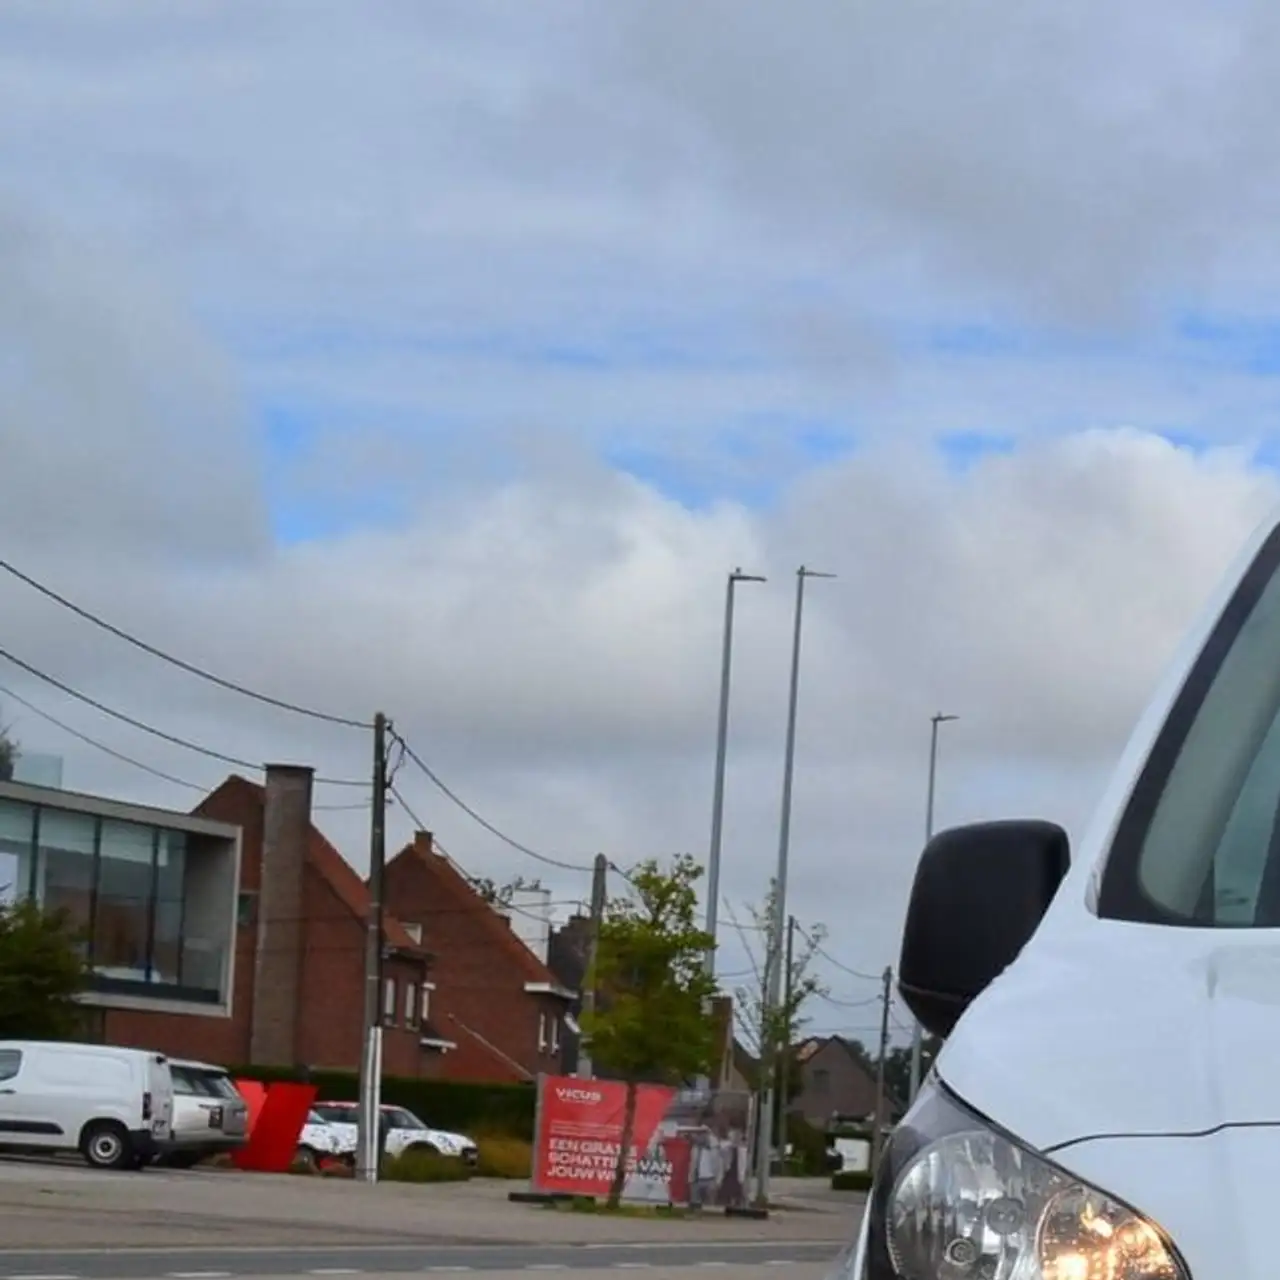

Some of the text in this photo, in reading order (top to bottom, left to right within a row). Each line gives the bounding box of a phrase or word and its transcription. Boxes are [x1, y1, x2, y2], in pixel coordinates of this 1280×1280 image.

[555, 1087, 601, 1101] VICUS
[550, 1138, 578, 1151] EEN
[547, 1166, 594, 1180] JOUW
[640, 1159, 673, 1173] VAN
